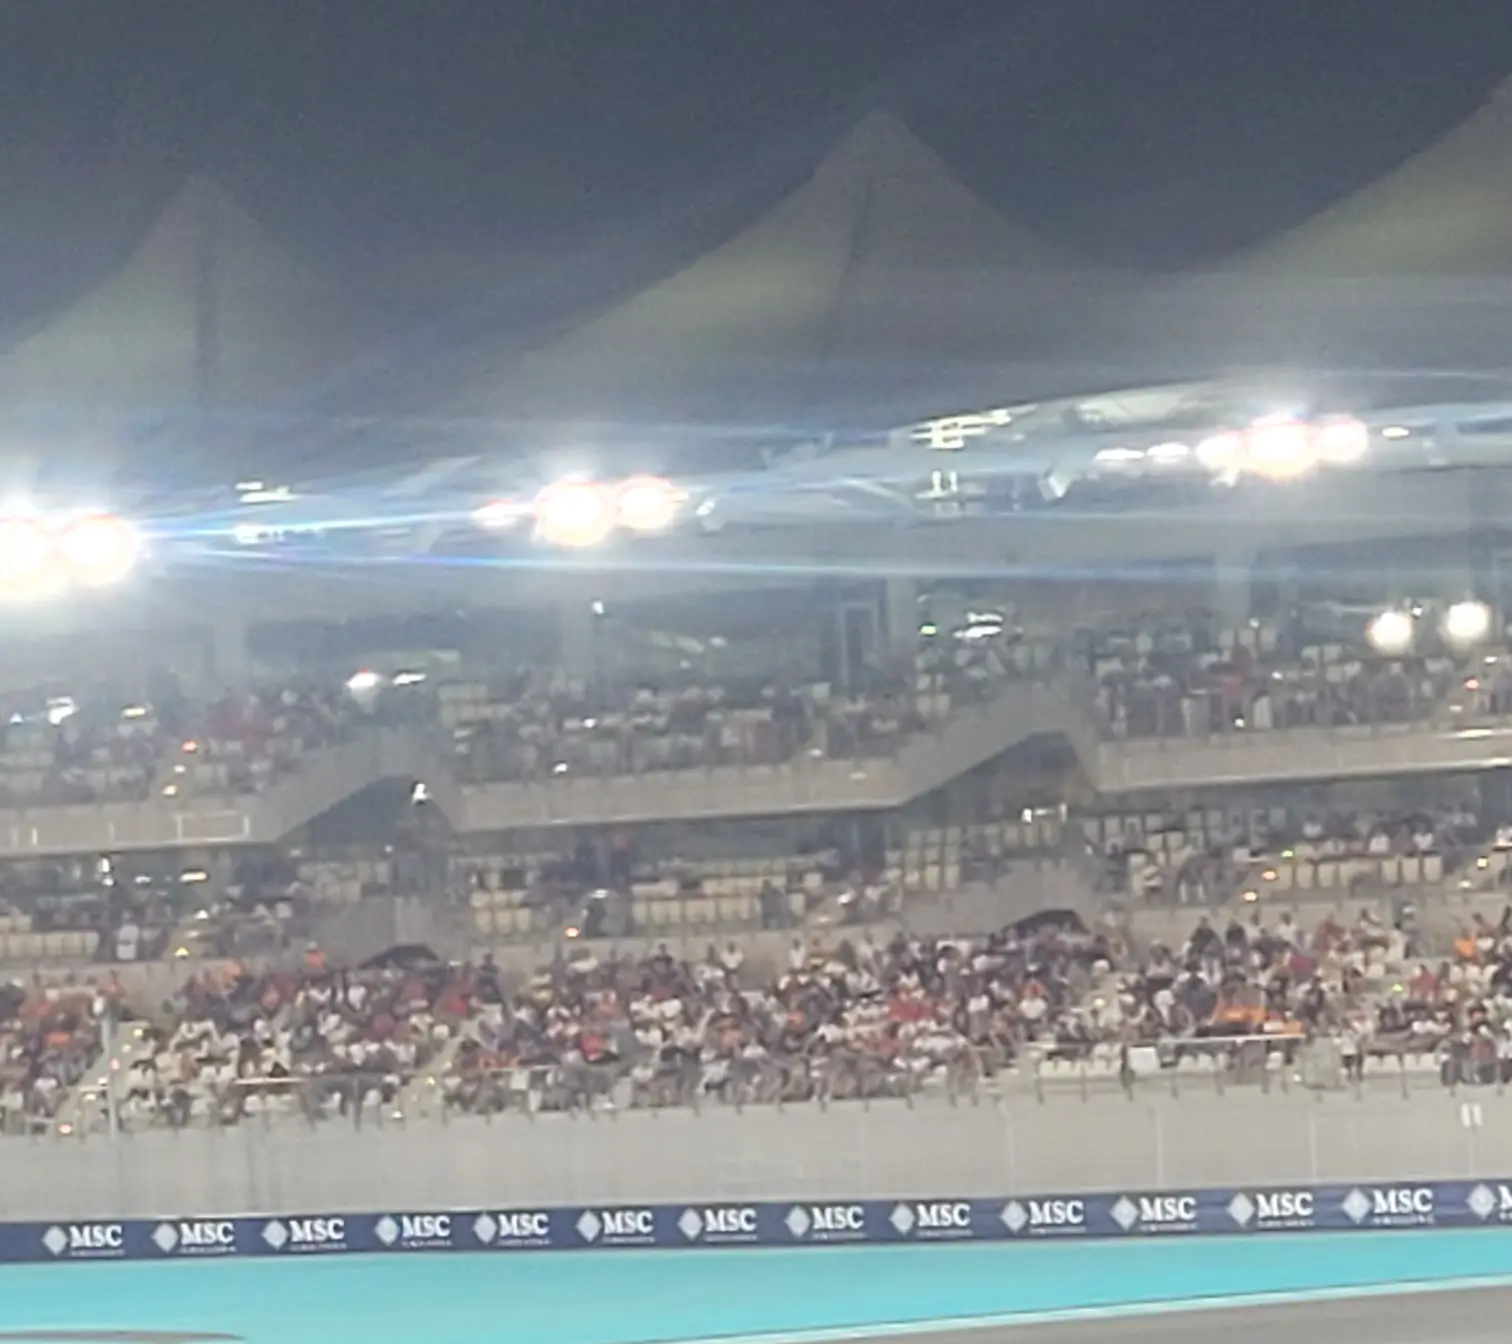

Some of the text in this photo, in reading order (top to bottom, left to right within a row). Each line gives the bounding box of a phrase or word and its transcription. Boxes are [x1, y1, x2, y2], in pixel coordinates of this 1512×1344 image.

[1028, 1200, 1084, 1225] MSC
[1139, 1196, 1196, 1221] MSC
[1256, 1192, 1313, 1218] MSC
[1373, 1188, 1433, 1214] MSC
[401, 1215, 450, 1238] MSC
[498, 1213, 549, 1237] MSC
[602, 1211, 653, 1234] MSC
[704, 1208, 756, 1232] MSC
[812, 1206, 864, 1230] MSC
[917, 1203, 970, 1227] MSC
[69, 1225, 122, 1248] MSC
[180, 1222, 234, 1245] MSC
[289, 1218, 345, 1242] MSC
